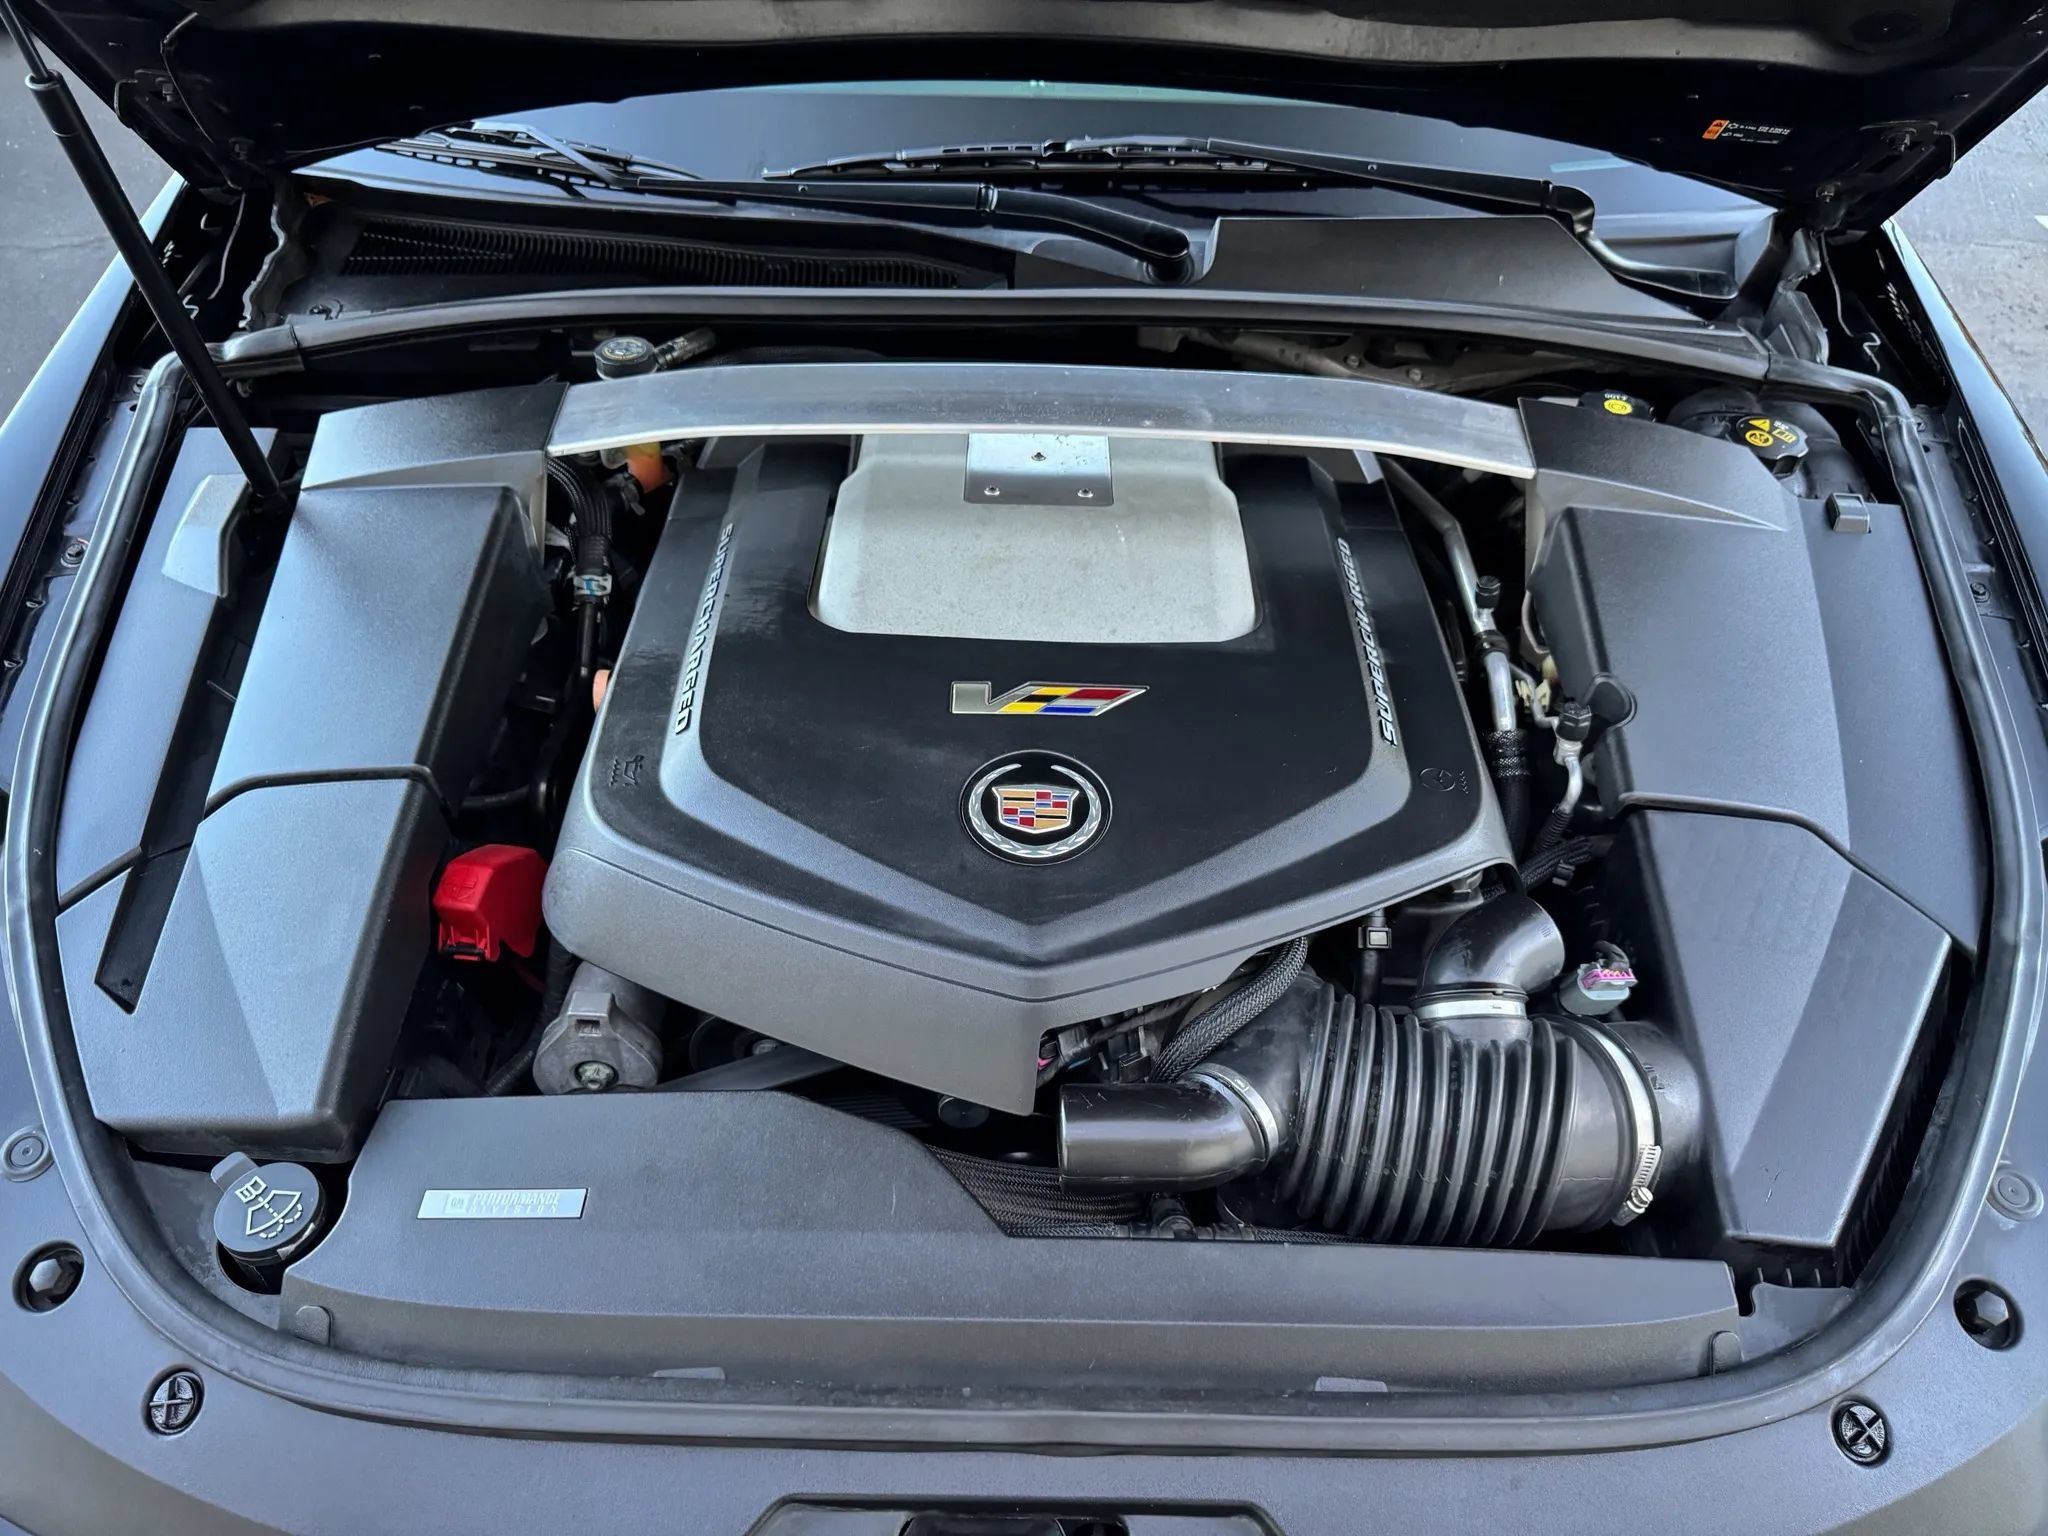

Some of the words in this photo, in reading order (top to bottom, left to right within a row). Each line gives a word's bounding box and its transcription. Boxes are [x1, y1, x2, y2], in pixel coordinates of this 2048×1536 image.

[674, 523, 733, 735] SUPERCHARGED
[1337, 537, 1398, 748] SUPERCHARGED
[473, 1191, 561, 1206] PERFORMANCE
